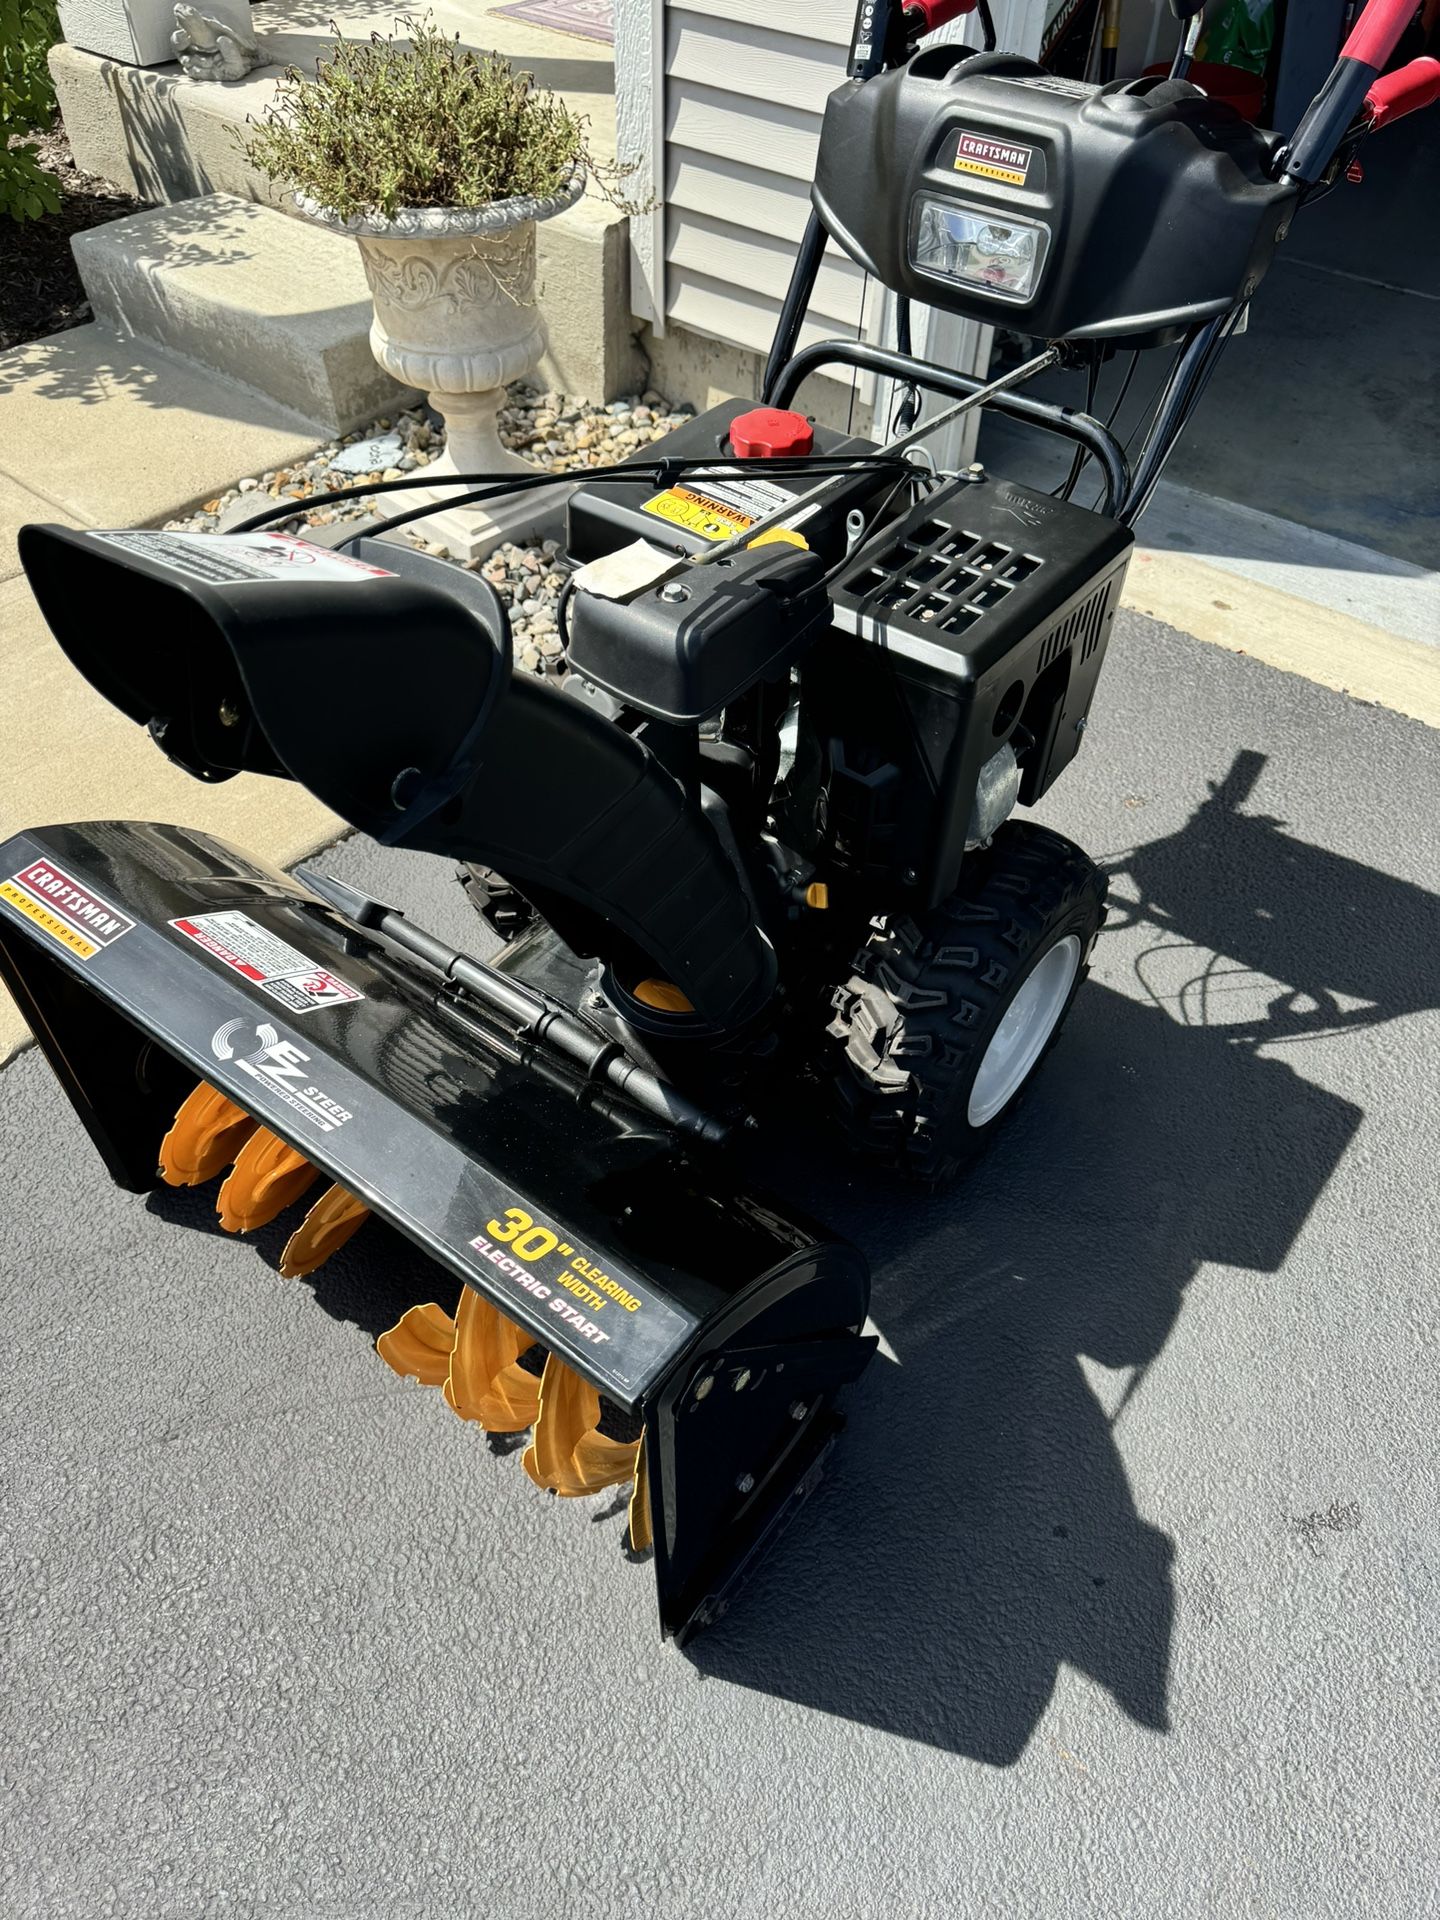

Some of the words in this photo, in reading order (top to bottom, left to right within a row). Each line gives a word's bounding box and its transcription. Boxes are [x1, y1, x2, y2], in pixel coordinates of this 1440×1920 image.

[959, 161, 1021, 181] PROFESSIONAL
[962, 140, 1025, 165] CRAFTSMAN
[685, 493, 747, 523] WARNING
[4, 887, 89, 953] PROFESSIONAL
[28, 867, 121, 935] CRAFTSMAN
[194, 932, 238, 961] DANGER
[254, 1073, 289, 1101] POWERED
[289, 1097, 326, 1127] STEERING
[303, 1086, 353, 1122] STEER
[486, 1207, 575, 1262] 30"
[570, 1257, 642, 1312] CLEARING
[468, 1235, 552, 1300] ELECTRIC
[549, 1298, 610, 1344] START
[557, 1270, 608, 1312] WIDTH
